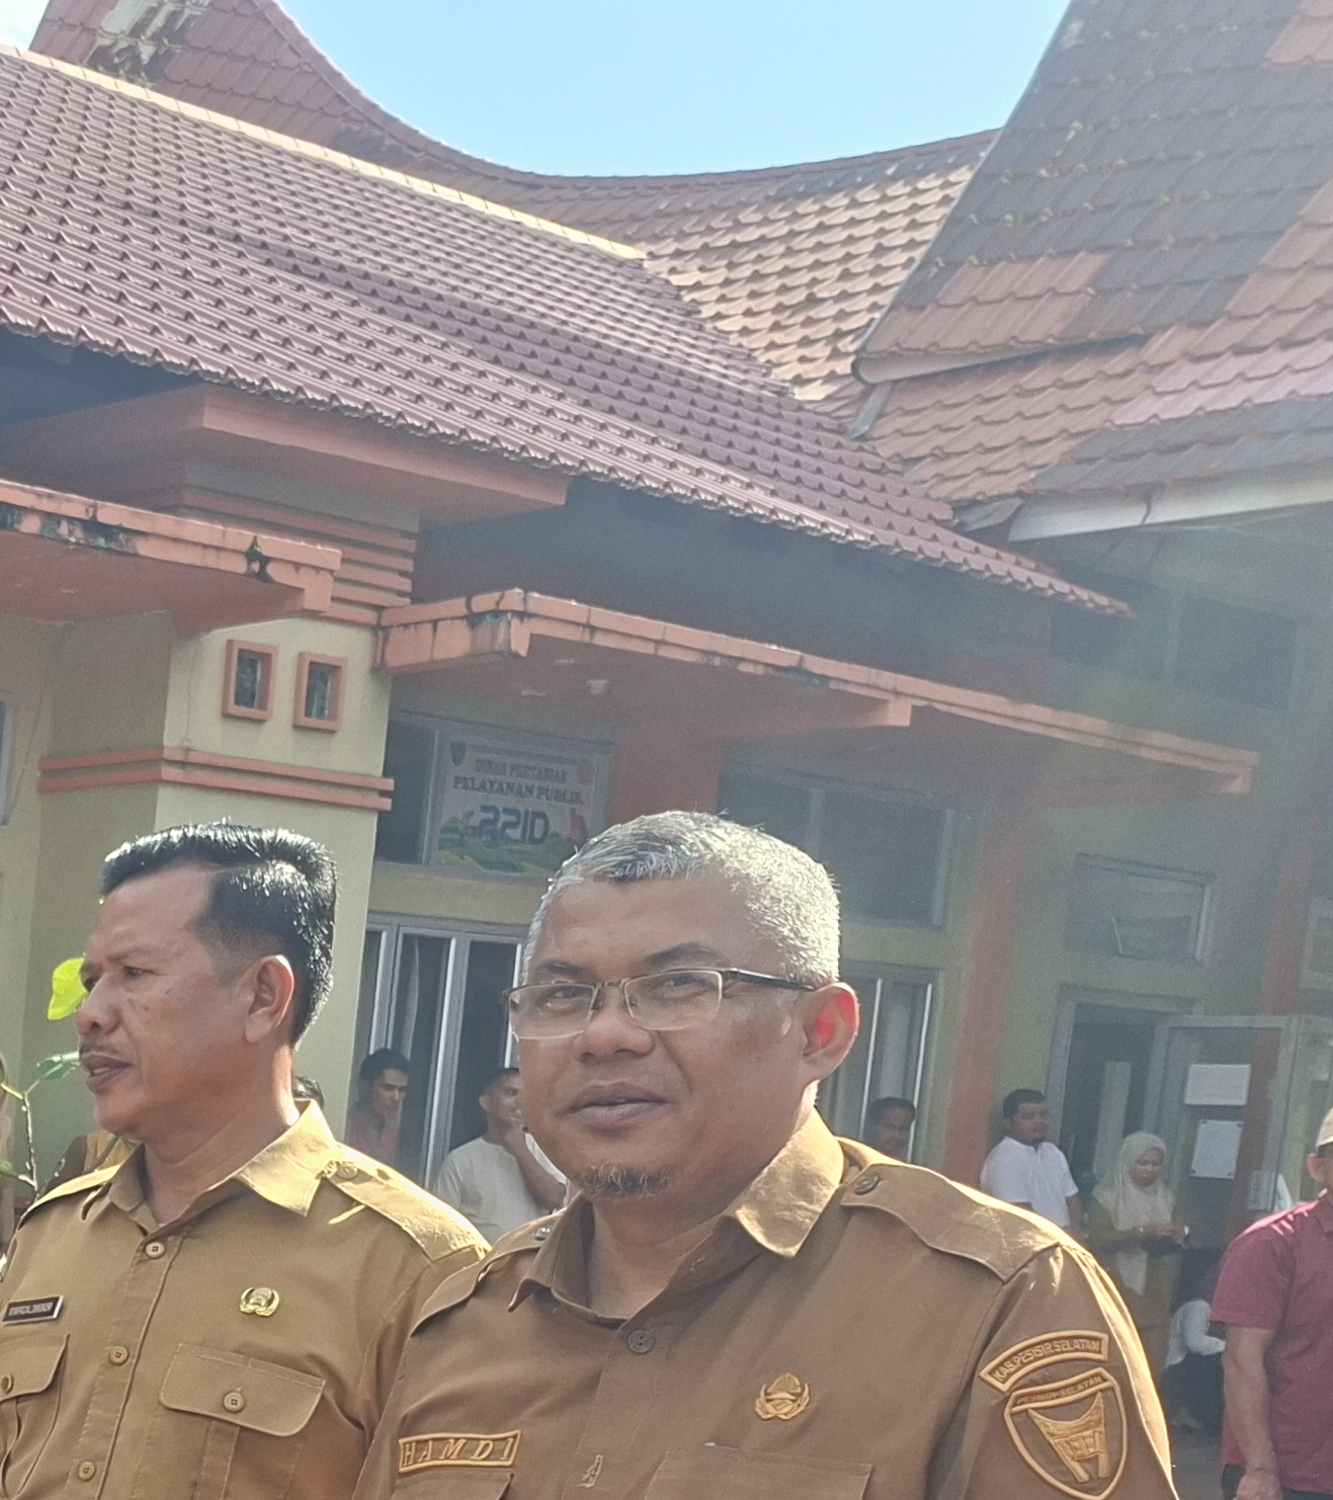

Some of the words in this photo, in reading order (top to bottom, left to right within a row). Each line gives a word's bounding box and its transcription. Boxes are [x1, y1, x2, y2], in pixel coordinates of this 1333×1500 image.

[453, 774, 534, 798] PELAYANAN
[536, 785, 585, 806] PUBLIK
[402, 1437, 515, 1467] HAMDI
